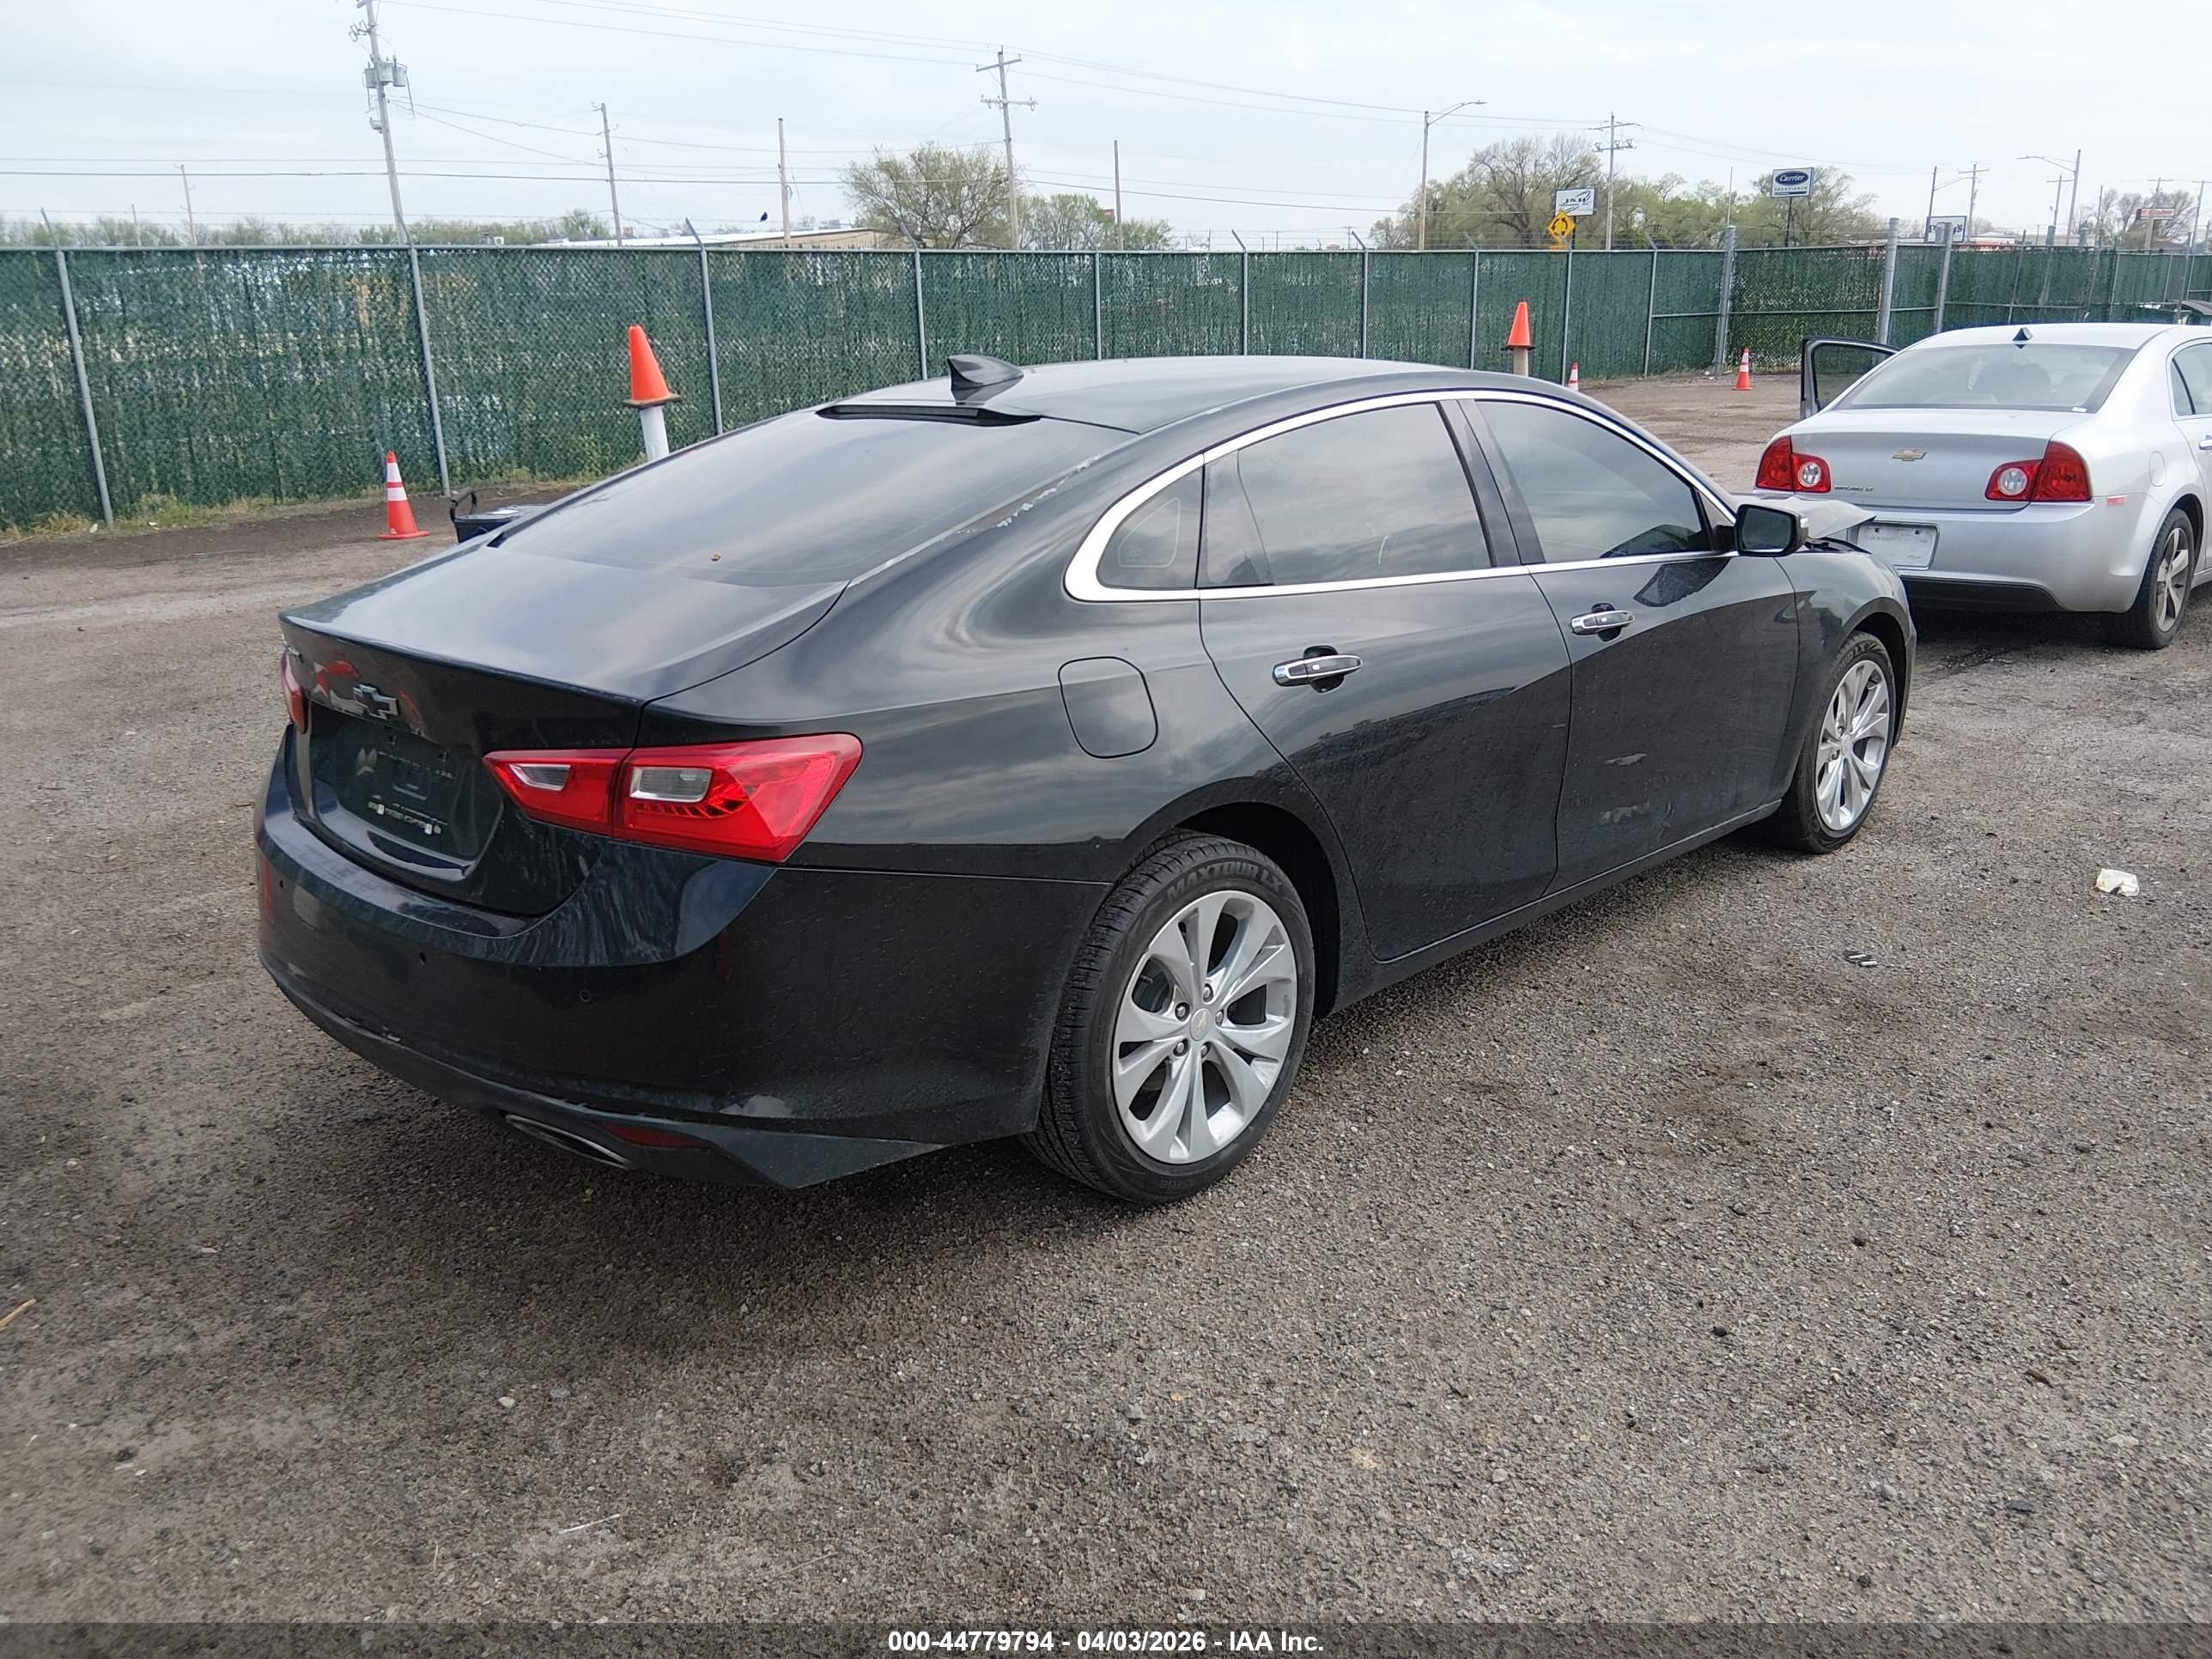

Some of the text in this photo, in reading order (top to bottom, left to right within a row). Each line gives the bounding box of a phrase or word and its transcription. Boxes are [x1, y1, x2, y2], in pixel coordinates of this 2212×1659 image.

[1779, 173, 1805, 182] Carrier
[1167, 861, 1283, 901] MAXTOUR LX
